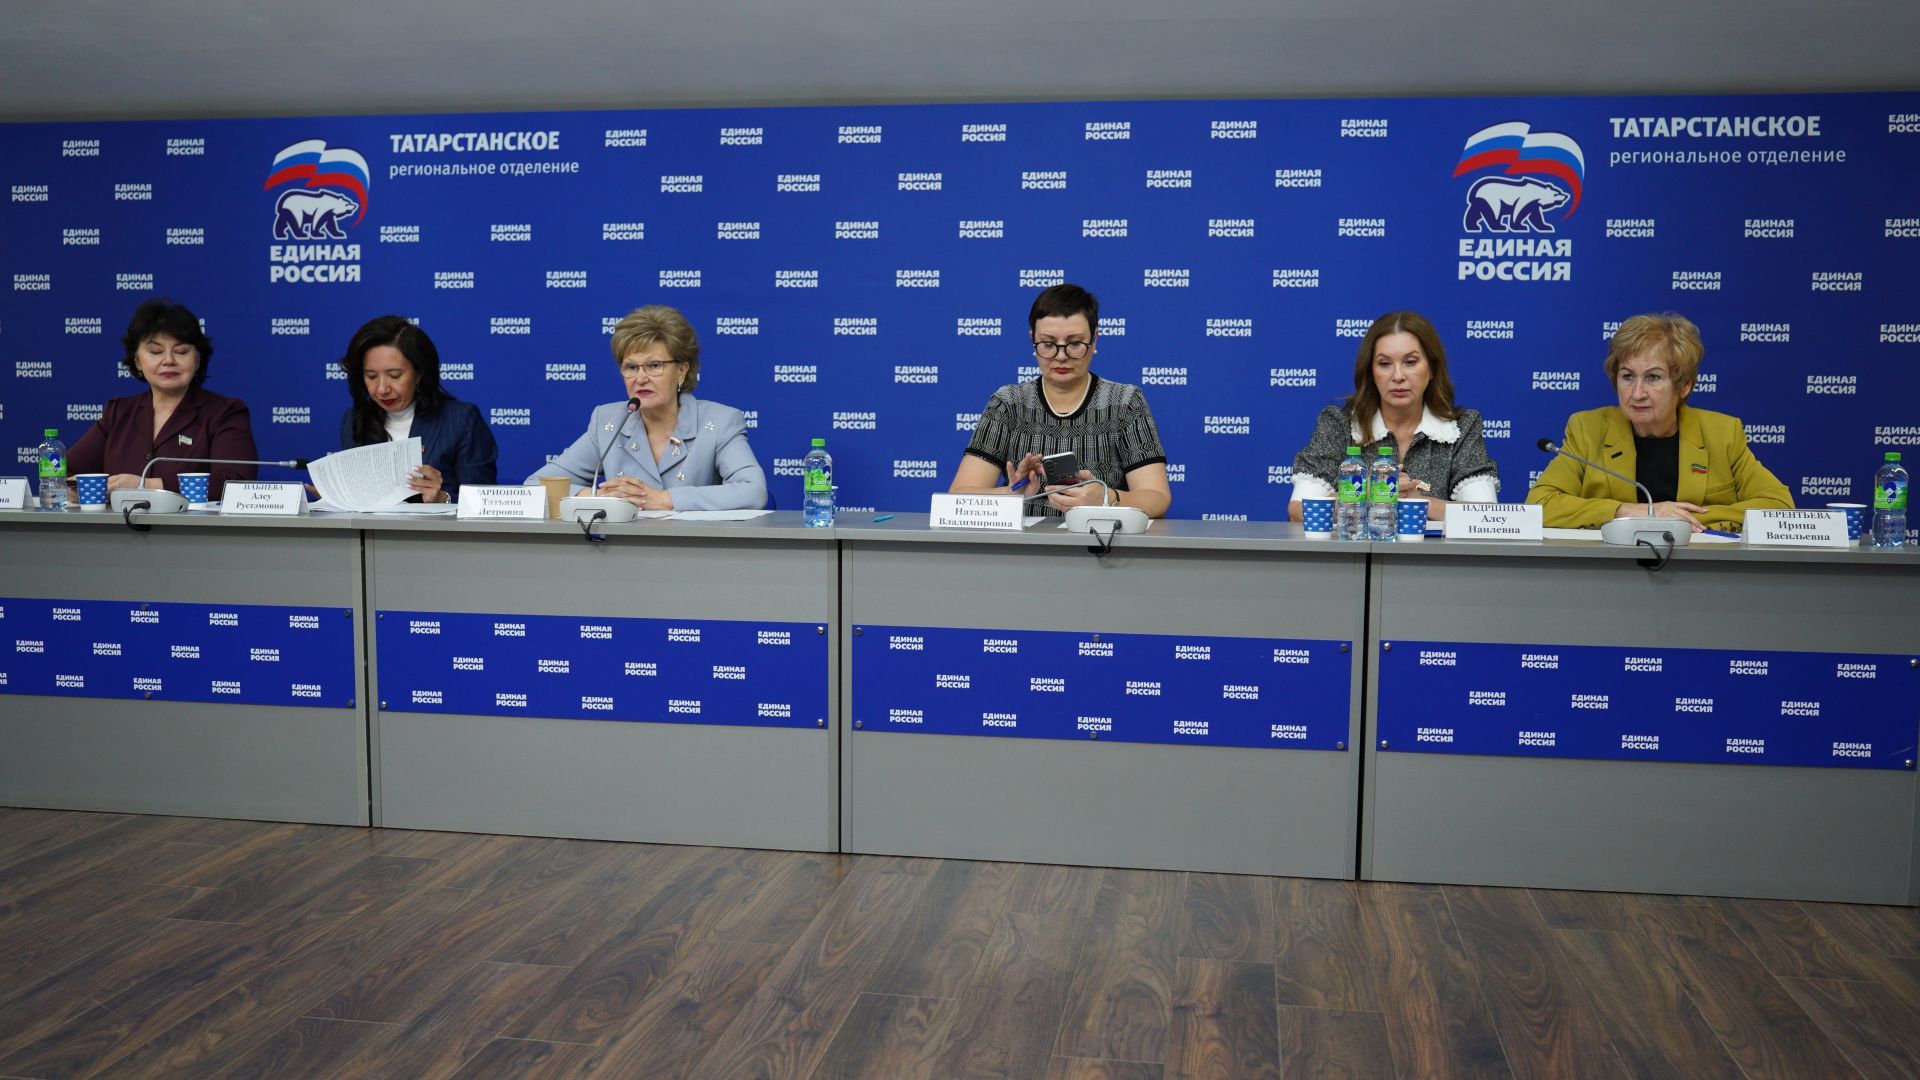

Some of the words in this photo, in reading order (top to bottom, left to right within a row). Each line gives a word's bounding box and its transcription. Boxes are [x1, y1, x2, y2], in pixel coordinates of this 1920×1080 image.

[963, 124, 1006, 132] ЕДИНАЯ
[1211, 121, 1257, 129] ЕДИНАЯ
[1610, 115, 1821, 138] ТАТАРСТАНСКОЕ
[721, 128, 763, 136] ЕДИНАЯ
[839, 126, 882, 134] ЕДИНАЯ
[1211, 130, 1256, 138] РОССИЯ
[720, 137, 762, 145] РОССИЯ
[838, 135, 881, 143] РОССИЯ
[962, 133, 1006, 141] РОССИЯ
[390, 131, 560, 153] ТАТАРСТАНСКОЕ
[167, 147, 204, 155] РОССИЯ
[1610, 151, 1742, 167] региональное
[1747, 149, 1846, 165] отделение
[390, 163, 496, 179] региональное
[499, 161, 580, 176] отделение
[1147, 170, 1192, 178] ЕДИНАЯ
[1276, 169, 1321, 178] ЕДИНАЯ
[899, 173, 942, 181] ЕДИНАЯ
[898, 182, 941, 190] РОССИЯ
[1147, 179, 1191, 188] РОССИЯ
[1275, 179, 1321, 187] РОССИЯ
[661, 184, 702, 192] РОССИЯ
[115, 192, 152, 200] РОССИЯ
[1083, 220, 1127, 228] ЕДИНАЯ
[1339, 219, 1385, 227] ЕДИНАЯ
[1745, 219, 1794, 228] ЕДИНАЯ
[718, 231, 759, 239] РОССИЯ
[836, 230, 878, 239] РОССИЯ
[1083, 229, 1127, 237] РОССИЯ
[1339, 228, 1385, 236] РОССИЯ
[1745, 229, 1794, 238] РОССИЯ
[63, 237, 99, 245] РОССИЯ
[380, 234, 419, 242] РОССИЯ
[1459, 239, 1571, 260] ЕДИНАЯ
[270, 244, 360, 264] ЕДИНАЯ
[270, 264, 361, 283] РОССИЯ
[1020, 270, 1064, 278] ЕДИНАЯ
[1273, 270, 1319, 278] ЕДИНАЯ
[1458, 260, 1571, 281] РОССИЯ
[14, 274, 50, 282] ЕДИНАЯ
[435, 272, 474, 280] ЕДИНАЯ
[546, 271, 586, 279] ЕДИНАЯ
[1673, 272, 1721, 280] ЕДИНАЯ
[546, 280, 586, 288] РОССИЯ
[776, 279, 818, 287] РОССИЯ
[1020, 279, 1064, 287] РОССИЯ
[1273, 279, 1318, 287] РОССИЯ
[1672, 281, 1720, 290] РОССИЯ
[834, 318, 877, 326] ЕДИНАЯ
[958, 318, 1001, 326] ЕДИНАЯ
[1336, 319, 1375, 328] ЕДИНА
[1467, 321, 1513, 329] ЕДИНАЯ
[65, 326, 101, 334] РОССИЯ
[491, 326, 530, 334] РОССИЯ
[834, 327, 877, 335] РОССИЯ
[958, 327, 1001, 335] РОССИЯ
[1336, 328, 1367, 337] РОСС
[1467, 330, 1513, 339] РОССИЯ
[439, 363, 474, 371] ДИНАЯ
[895, 366, 938, 374] ЕДИНАЯ
[440, 372, 474, 380] ОССИЯ
[546, 372, 586, 380] РОССИЯ
[1271, 369, 1316, 377] ЕДИНАЯ
[895, 375, 938, 383] РОССИЯ
[1270, 378, 1316, 386] РОССИЯ
[1807, 376, 1856, 384] ЕДИНАЯ
[1807, 385, 1856, 394] РОССИЯ
[491, 417, 530, 425] РОССИЯ
[1205, 416, 1249, 424] ЕДИНАЯ
[1204, 425, 1249, 434] РОССИЯ
[1743, 425, 1785, 433] ДИНАЯ
[1746, 434, 1785, 443] ОССИЯ
[1802, 477, 1851, 485] ЕДИНАЯ
[1802, 486, 1850, 495] РОССИЯ
[955, 498, 999, 506] БУТАЕВА
[955, 507, 999, 517] Наталья
[1462, 504, 1526, 512] НАДРШИНА
[939, 517, 1013, 529] Владимировна
[1481, 514, 1507, 524] Алсу
[1778, 521, 1816, 531] Ирина
[1766, 531, 1831, 541] Васильевна
